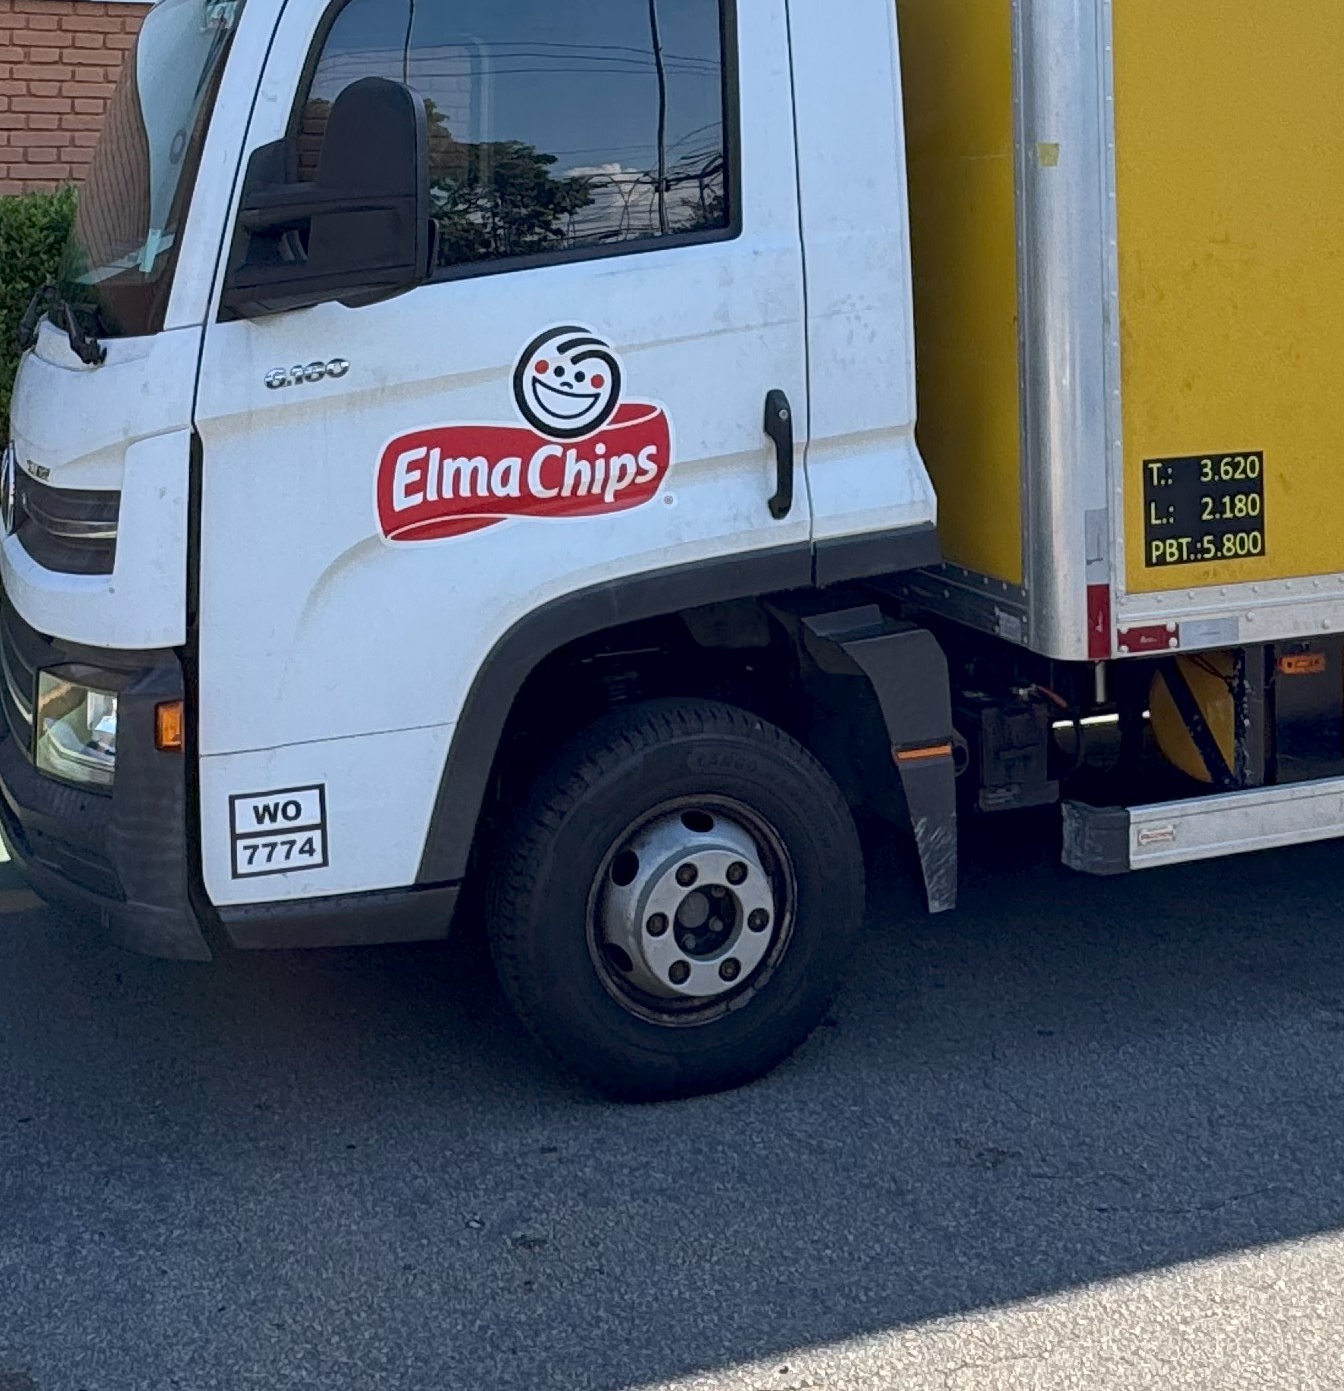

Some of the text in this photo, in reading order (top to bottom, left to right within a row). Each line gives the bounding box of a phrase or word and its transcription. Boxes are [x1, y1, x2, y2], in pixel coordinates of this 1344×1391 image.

[393, 443, 658, 512] Elma Chips
[1199, 455, 1260, 483] 3.620
[1201, 493, 1260, 521] 2.180
[253, 800, 302, 825] WO
[243, 836, 316, 865] 7774
